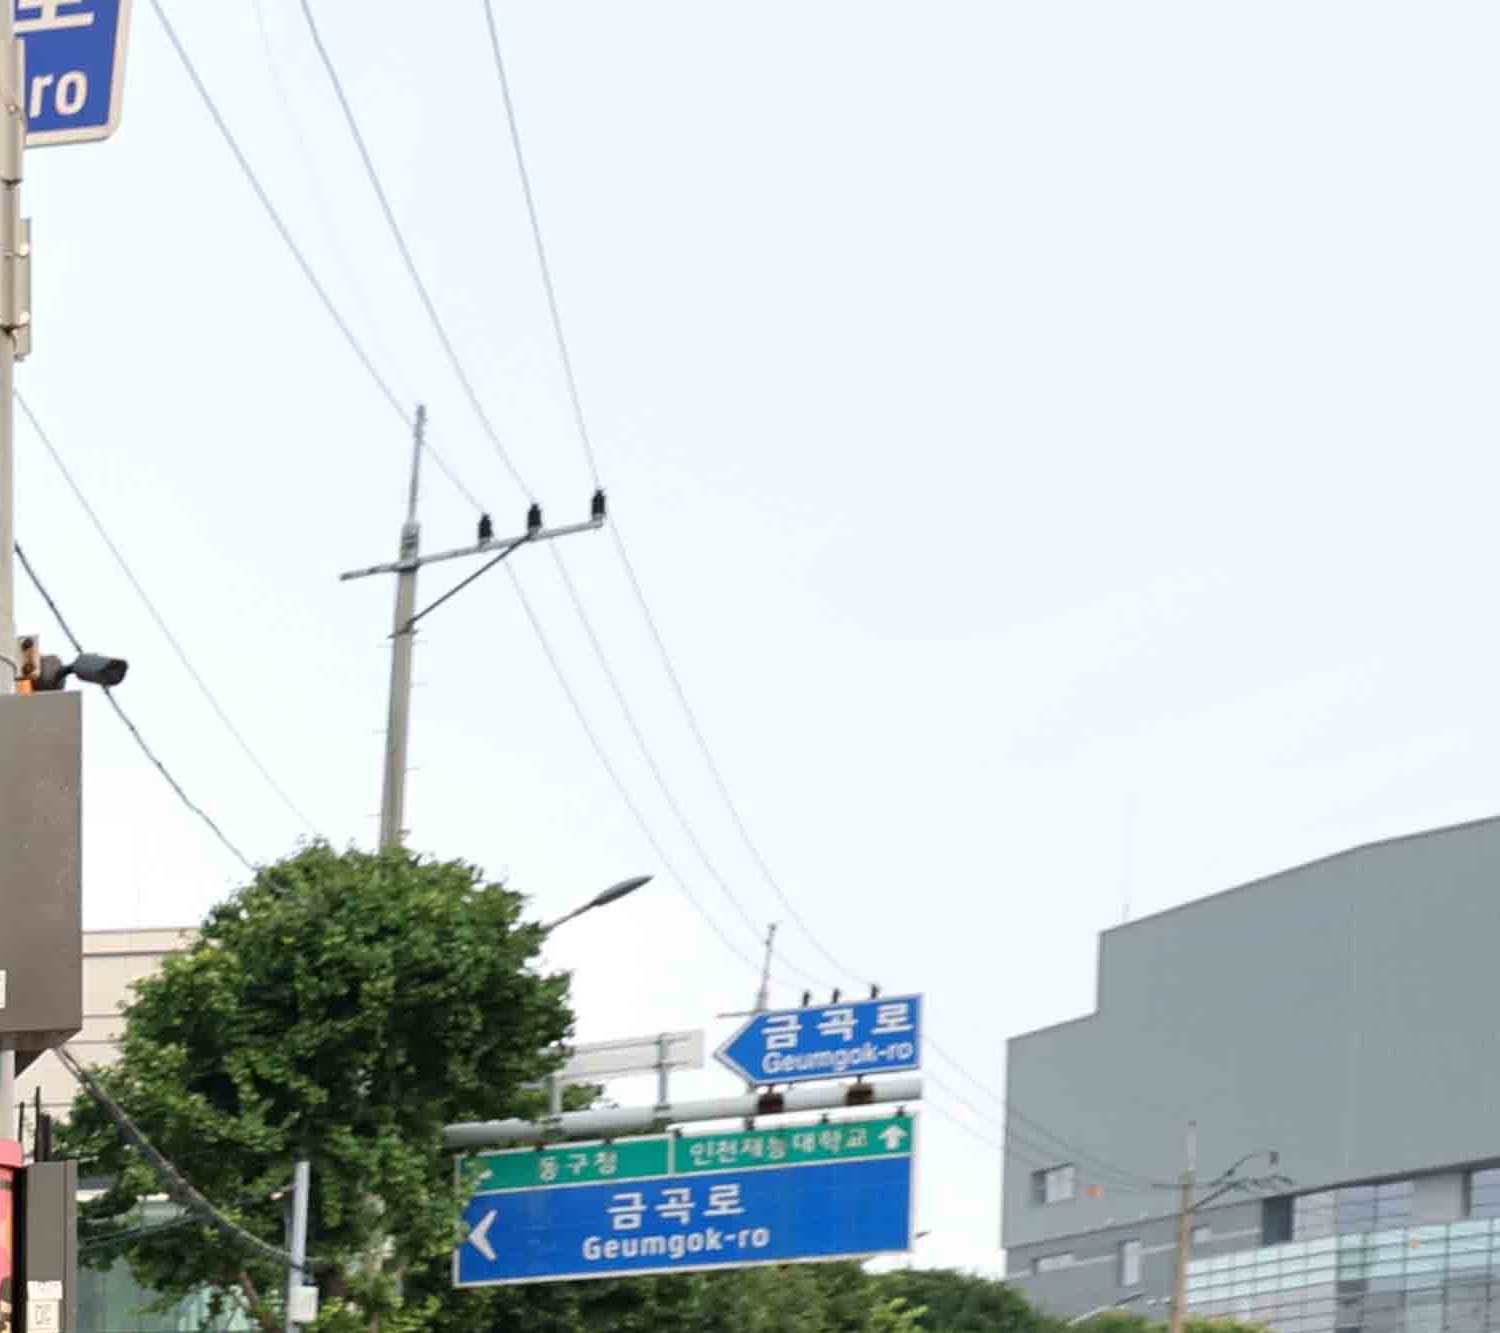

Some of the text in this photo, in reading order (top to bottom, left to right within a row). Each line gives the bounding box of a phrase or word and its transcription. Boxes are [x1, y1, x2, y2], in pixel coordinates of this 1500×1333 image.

[761, 1001, 914, 1050] 금곡로
[761, 1041, 914, 1076] Geumgok-ro
[689, 1124, 869, 1167] 인천재능대학교
[538, 1151, 619, 1181] 동구청
[606, 1183, 746, 1231] 금곡로
[582, 1227, 771, 1263] Geumgok-ro
